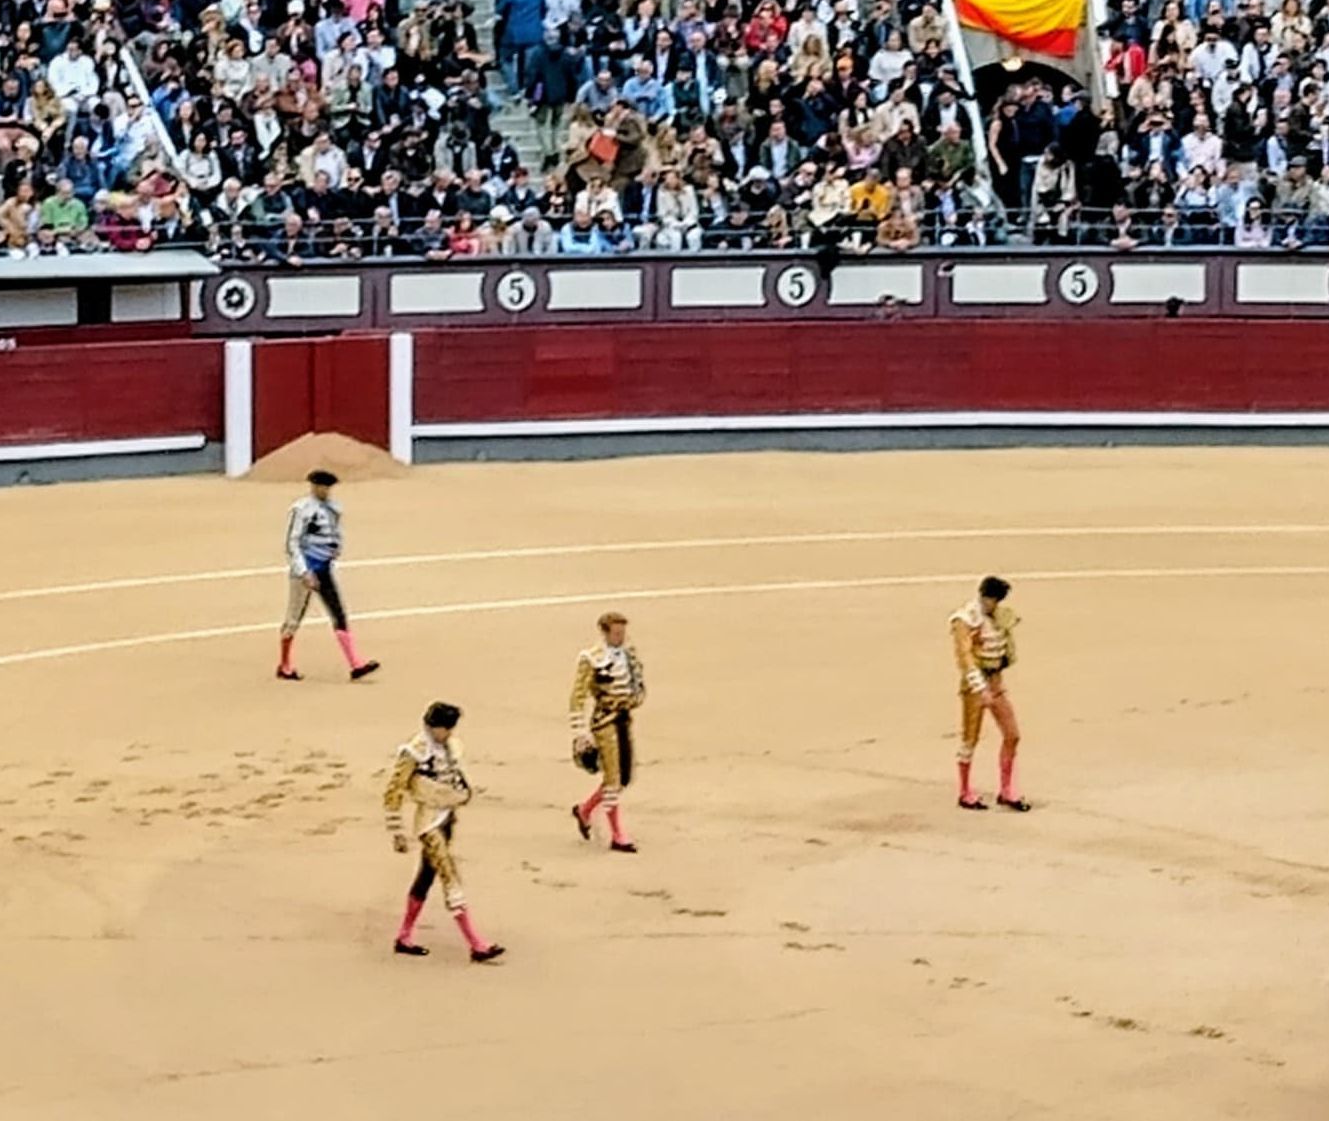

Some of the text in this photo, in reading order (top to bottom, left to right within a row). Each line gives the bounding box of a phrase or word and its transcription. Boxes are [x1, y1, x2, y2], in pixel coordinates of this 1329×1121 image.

[509, 277, 525, 306] 5
[789, 271, 805, 300] 5
[1071, 270, 1088, 298] 5
